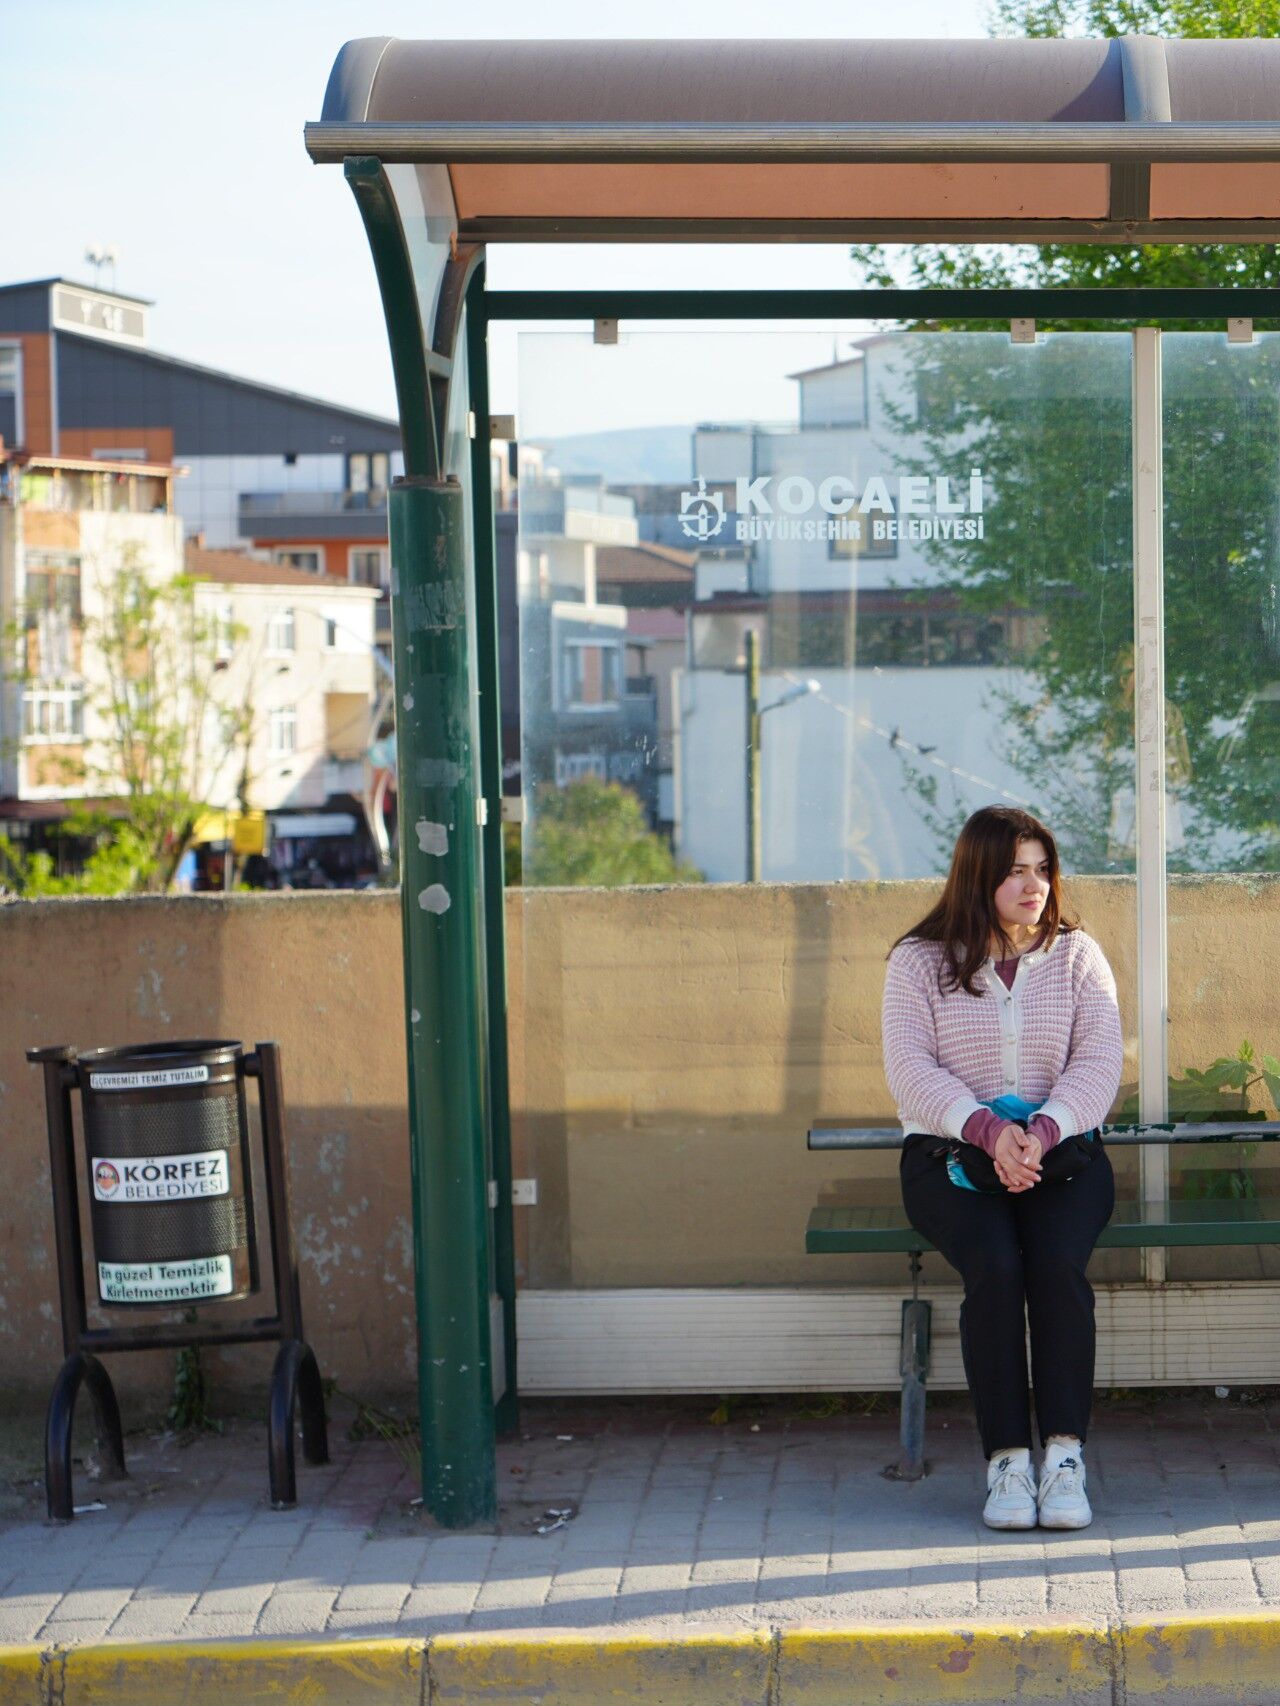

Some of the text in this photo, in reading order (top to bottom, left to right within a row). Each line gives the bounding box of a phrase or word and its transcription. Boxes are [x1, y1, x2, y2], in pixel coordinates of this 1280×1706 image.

[736, 468, 983, 514] KOCAELİ
[736, 516, 984, 542] BÜYÜKŞEHİR BELEDİYESİ
[141, 1073, 167, 1084] TEMİZ
[125, 1159, 222, 1182] KÖRFEZ
[125, 1179, 223, 1199] BELEDİYESİ
[115, 1265, 152, 1283] güzel
[159, 1260, 224, 1280] Temizlik
[106, 1279, 218, 1299] Kirletmemektir
